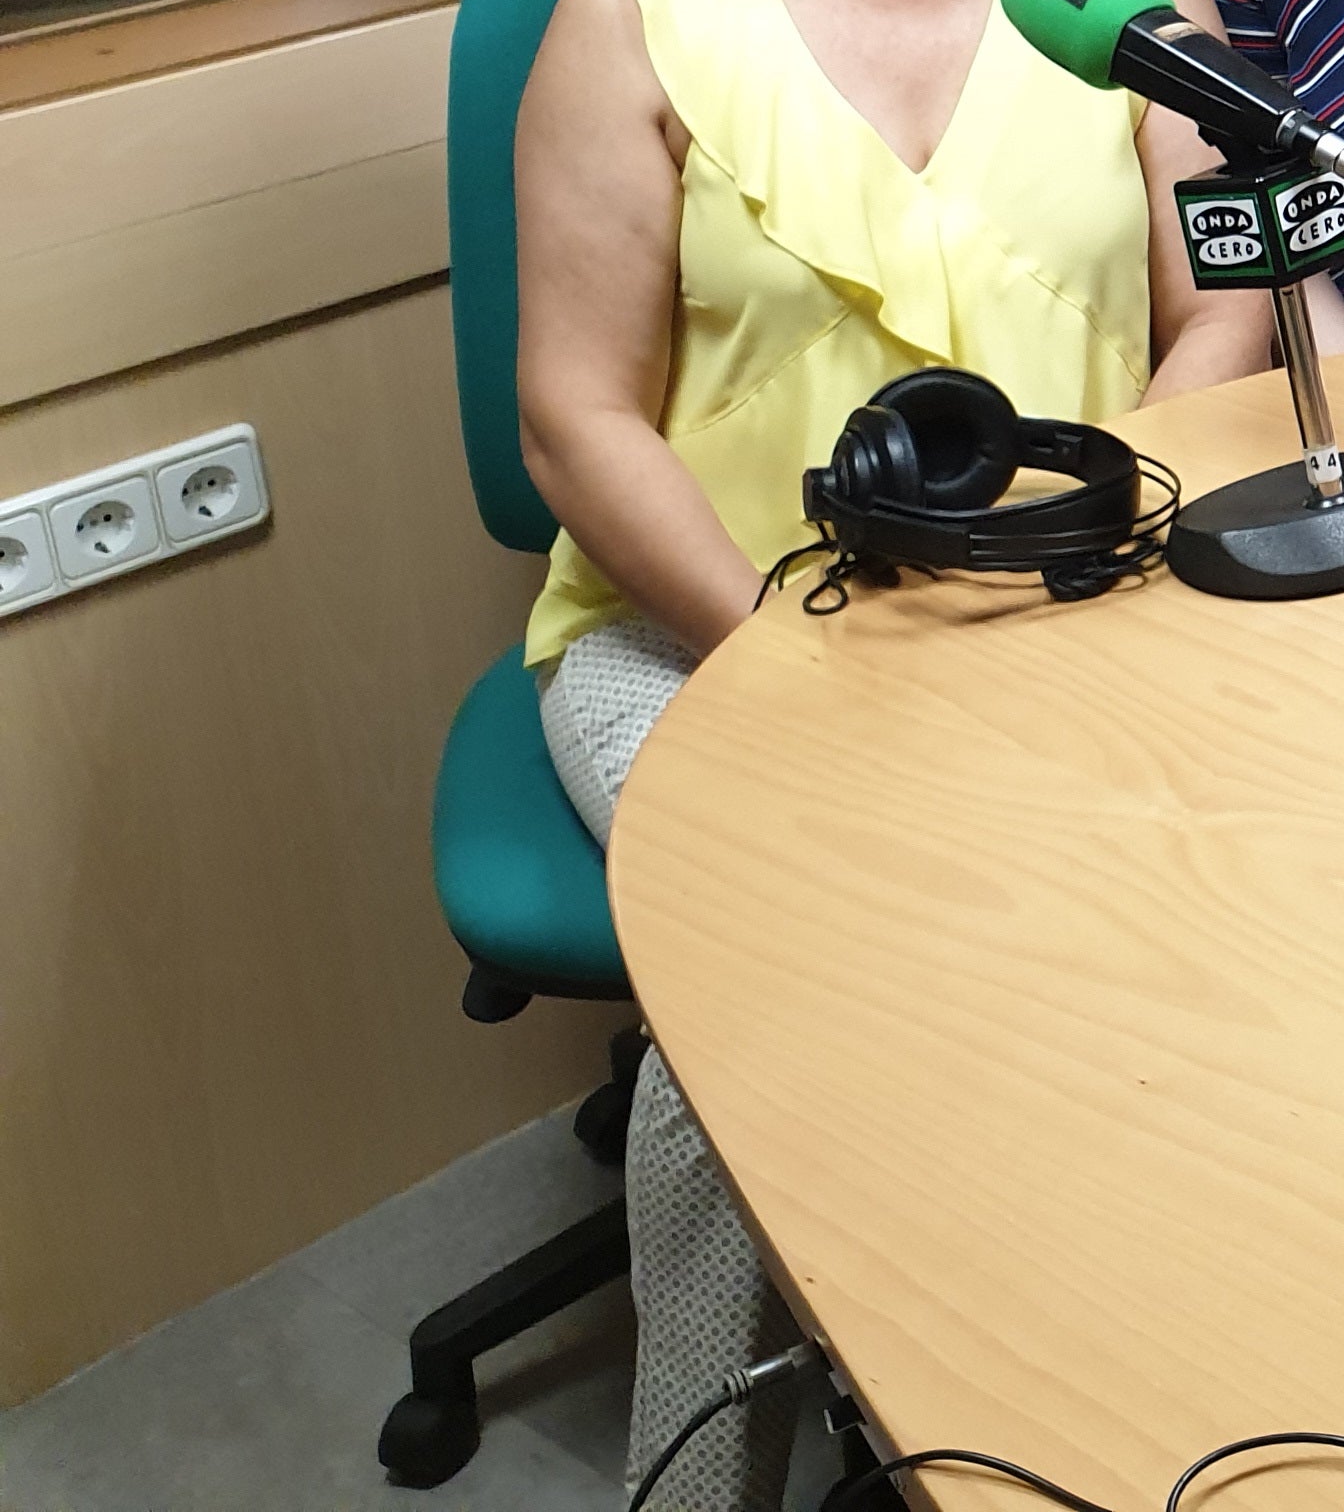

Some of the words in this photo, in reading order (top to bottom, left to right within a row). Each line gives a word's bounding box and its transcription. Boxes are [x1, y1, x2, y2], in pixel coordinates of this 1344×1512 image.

[1287, 184, 1341, 219] ONDA
[1196, 213, 1249, 231] ONDA
[1207, 242, 1254, 259] CERO
[1310, 455, 1320, 471] 4
[1327, 452, 1337, 467] 4
